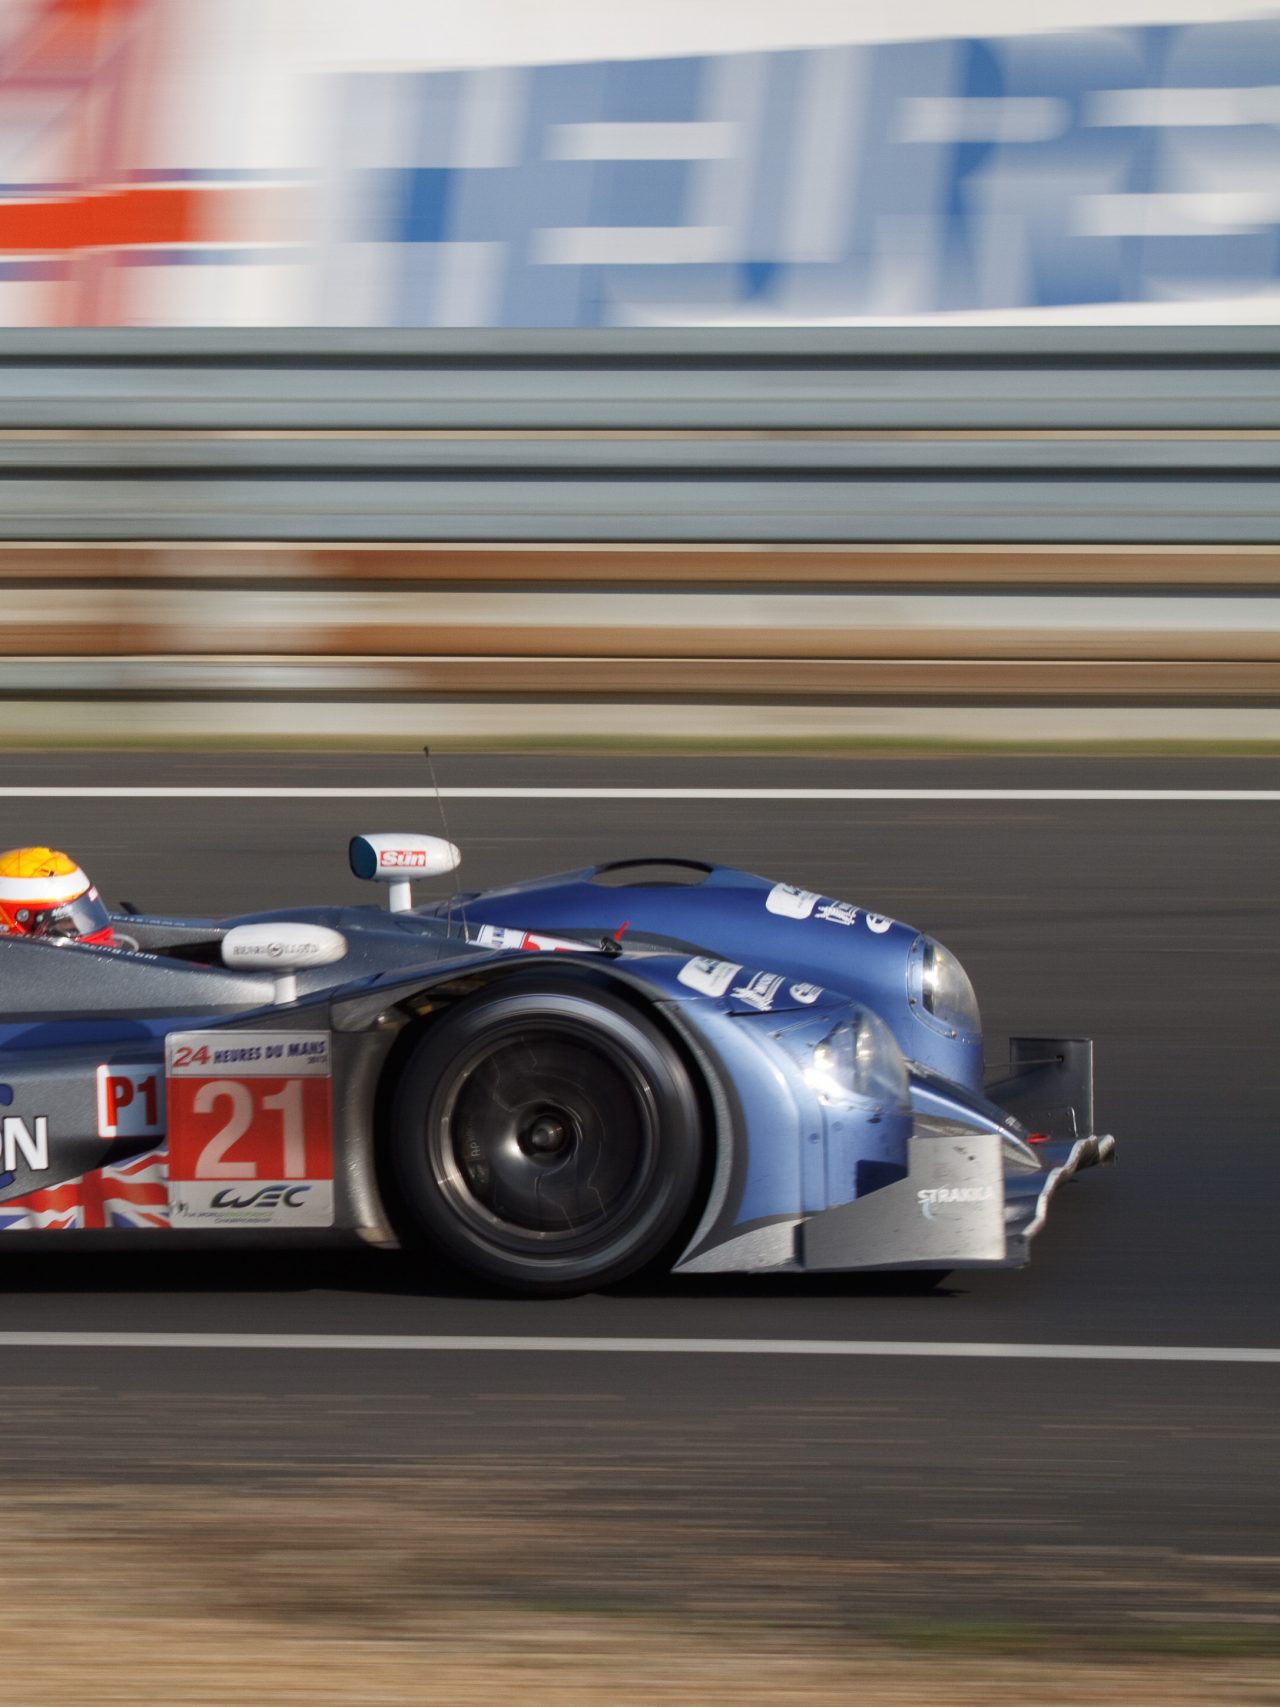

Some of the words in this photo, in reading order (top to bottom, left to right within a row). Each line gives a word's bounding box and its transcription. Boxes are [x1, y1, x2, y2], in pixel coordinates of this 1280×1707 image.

[381, 850, 426, 866] Sun
[172, 1045, 212, 1068] 24
[214, 1048, 261, 1065] HEURES
[265, 1045, 285, 1060] DU
[288, 1040, 327, 1057] MANS
[106, 1076, 158, 1127] P1
[193, 1080, 307, 1179] 21
[209, 1184, 313, 1209] WEC
